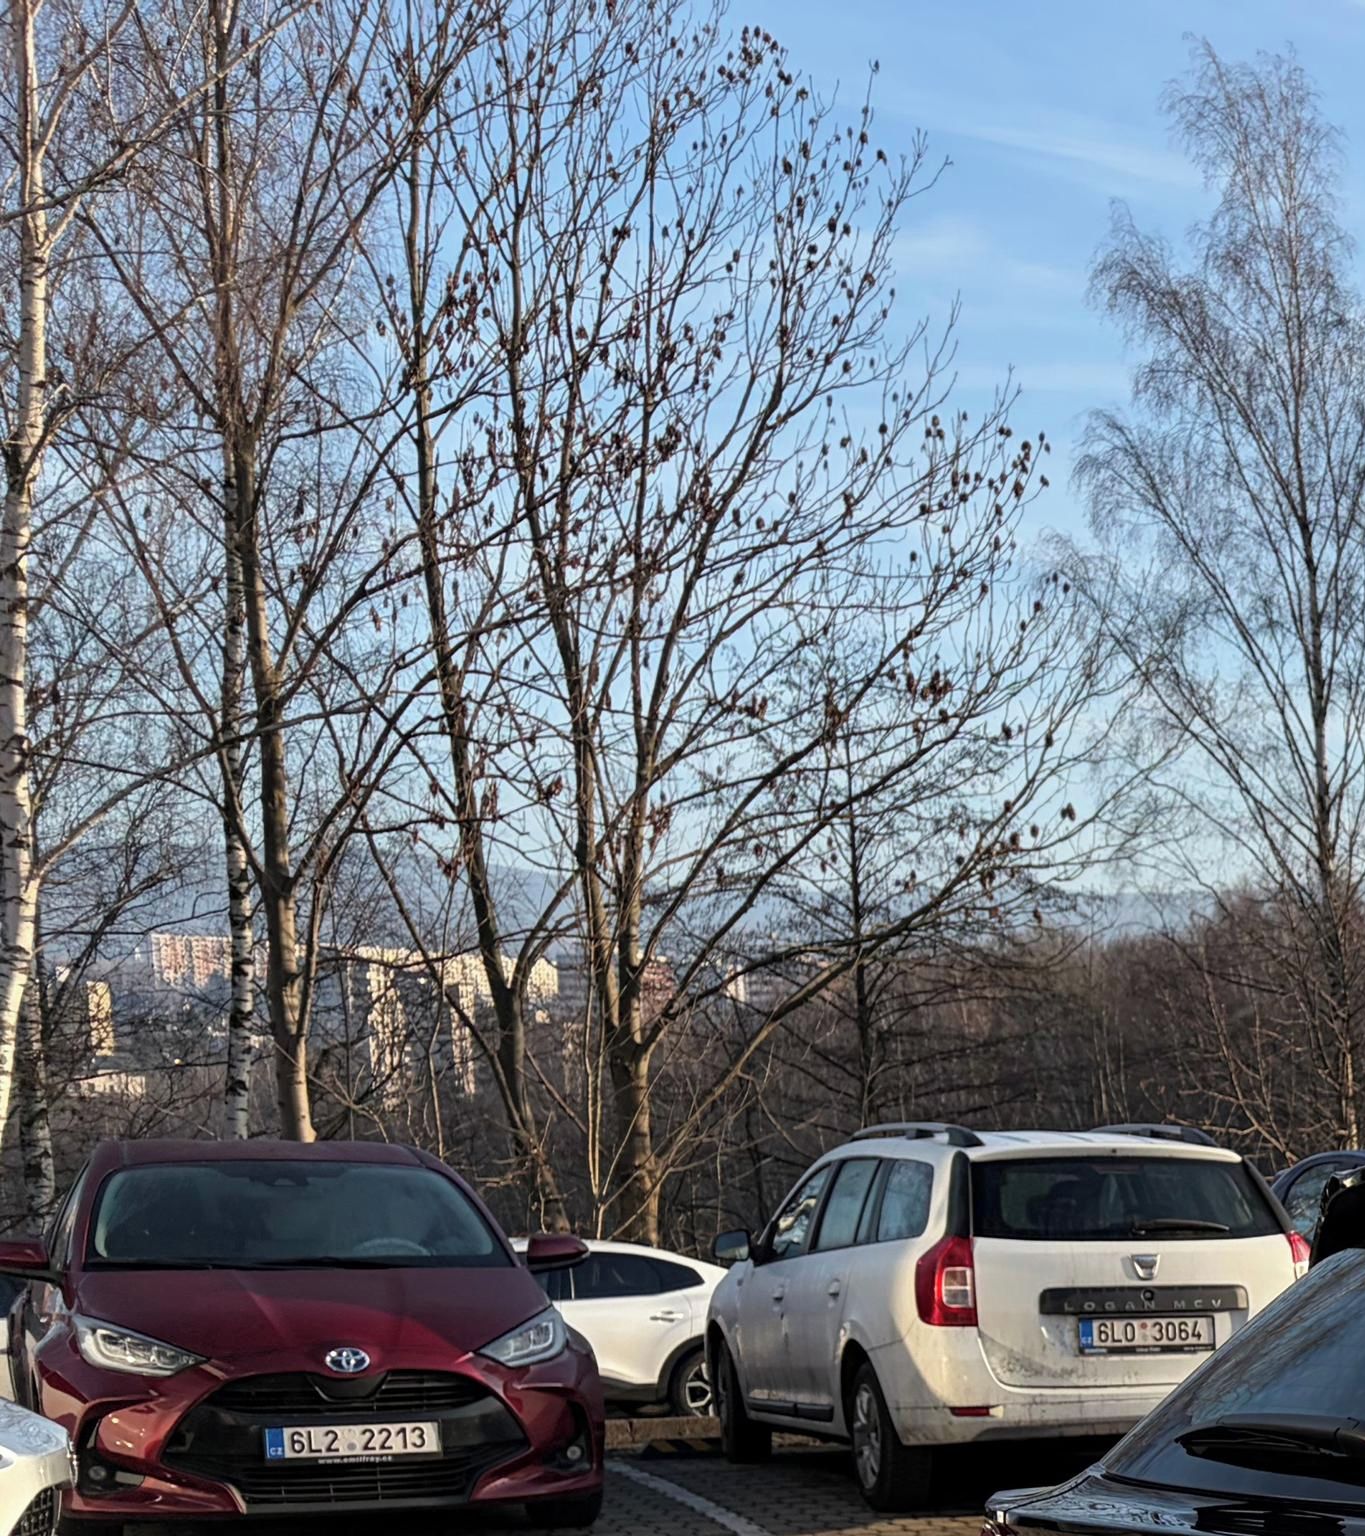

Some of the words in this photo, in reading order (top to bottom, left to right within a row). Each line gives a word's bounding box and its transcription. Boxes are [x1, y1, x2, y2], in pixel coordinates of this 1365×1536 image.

[1064, 1300, 1156, 1312] LOGAN
[1174, 1299, 1222, 1309] MCV
[1098, 1321, 1136, 1344] 6L0
[1152, 1320, 1203, 1342] 3064
[269, 1447, 284, 1456] CZ
[290, 1429, 341, 1455] 6L2
[361, 1426, 427, 1451] 2213
